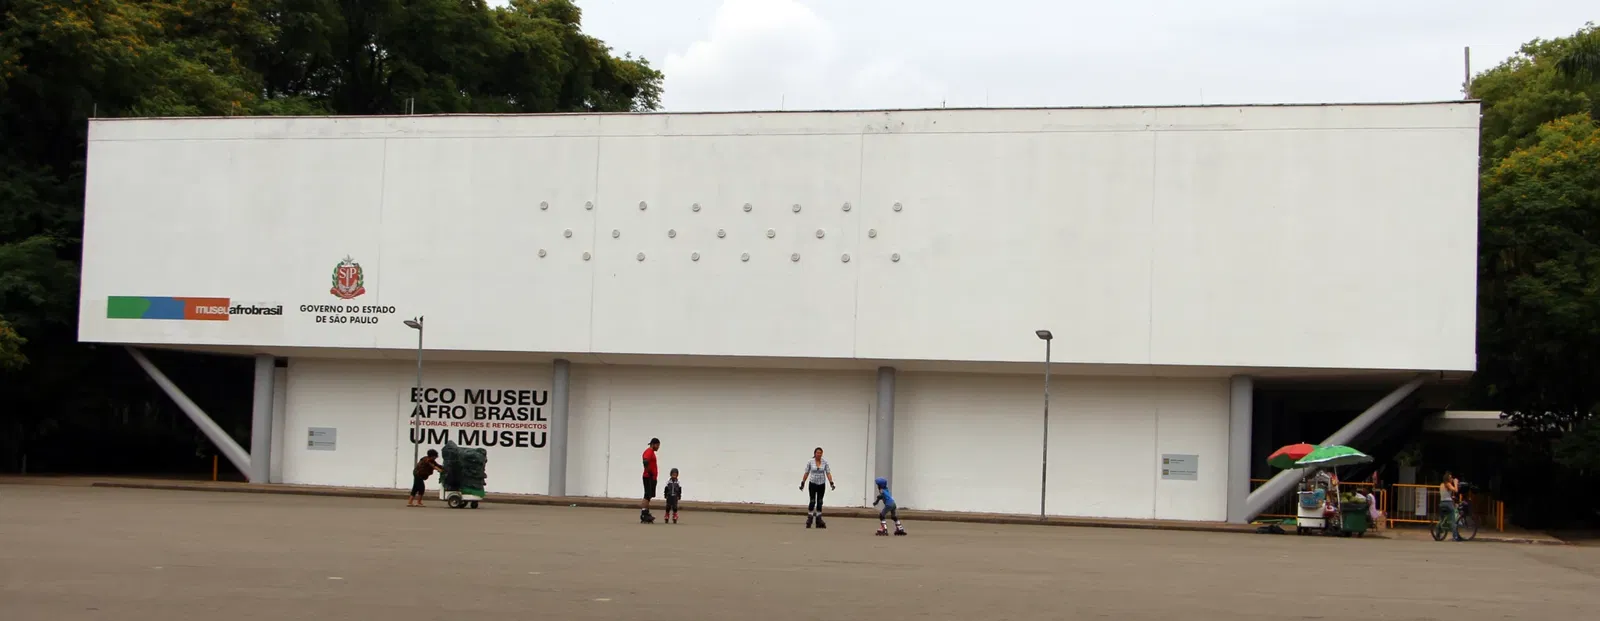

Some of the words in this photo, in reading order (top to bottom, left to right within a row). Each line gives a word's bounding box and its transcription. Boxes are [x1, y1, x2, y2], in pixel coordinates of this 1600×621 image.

[300, 304, 343, 313] GOVERNO
[346, 305, 359, 313] DO
[362, 305, 396, 314] ESTADO
[316, 315, 327, 323] DE
[329, 313, 347, 324] SÃO
[349, 315, 379, 324] PAULO
[411, 387, 456, 404] ECO
[464, 389, 547, 406] MUSEU
[410, 405, 467, 419] AFRO
[474, 406, 547, 421] BRASIL
[409, 428, 449, 445] UM
[458, 429, 547, 448] MUSEU
